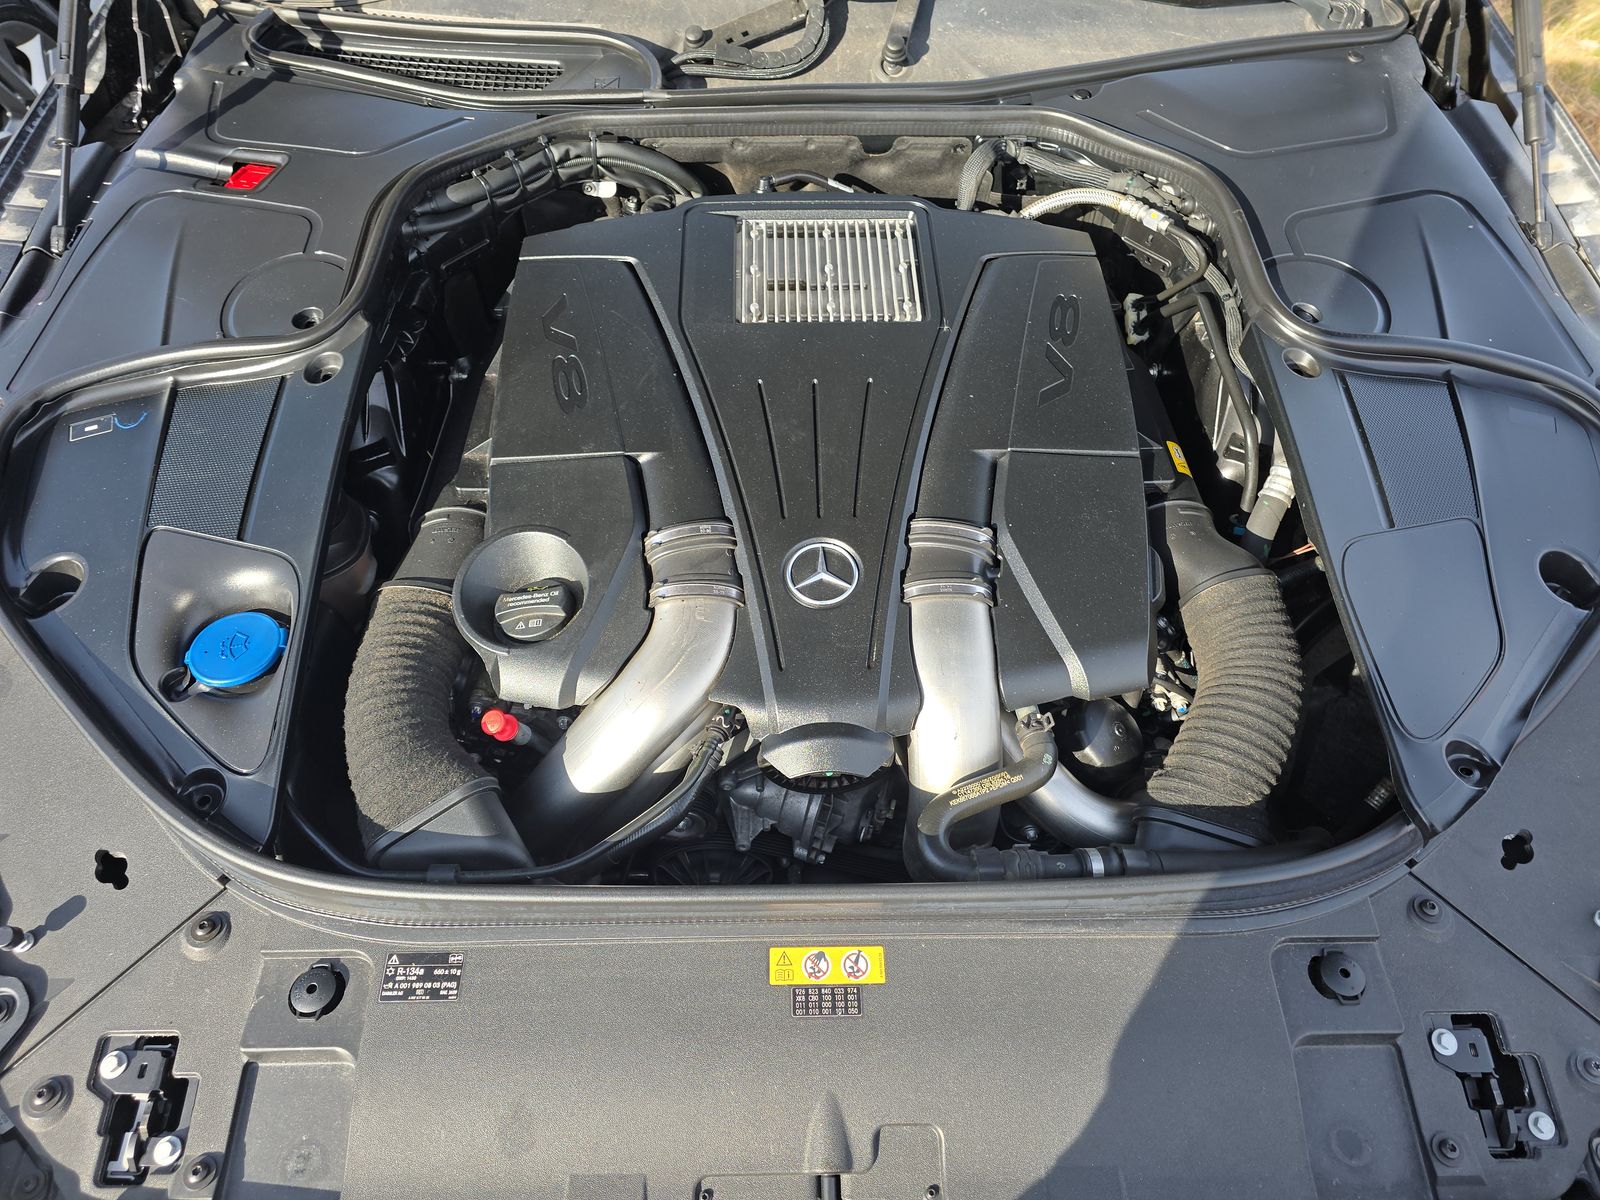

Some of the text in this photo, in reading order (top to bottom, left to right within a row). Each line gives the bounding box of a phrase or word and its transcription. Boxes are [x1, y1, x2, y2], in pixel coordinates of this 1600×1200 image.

[541, 292, 589, 414] V8
[1037, 293, 1081, 409] V8
[503, 592, 549, 602] Mercedes-Benz
[507, 597, 550, 607] recommended
[397, 967, 424, 976] R-134a
